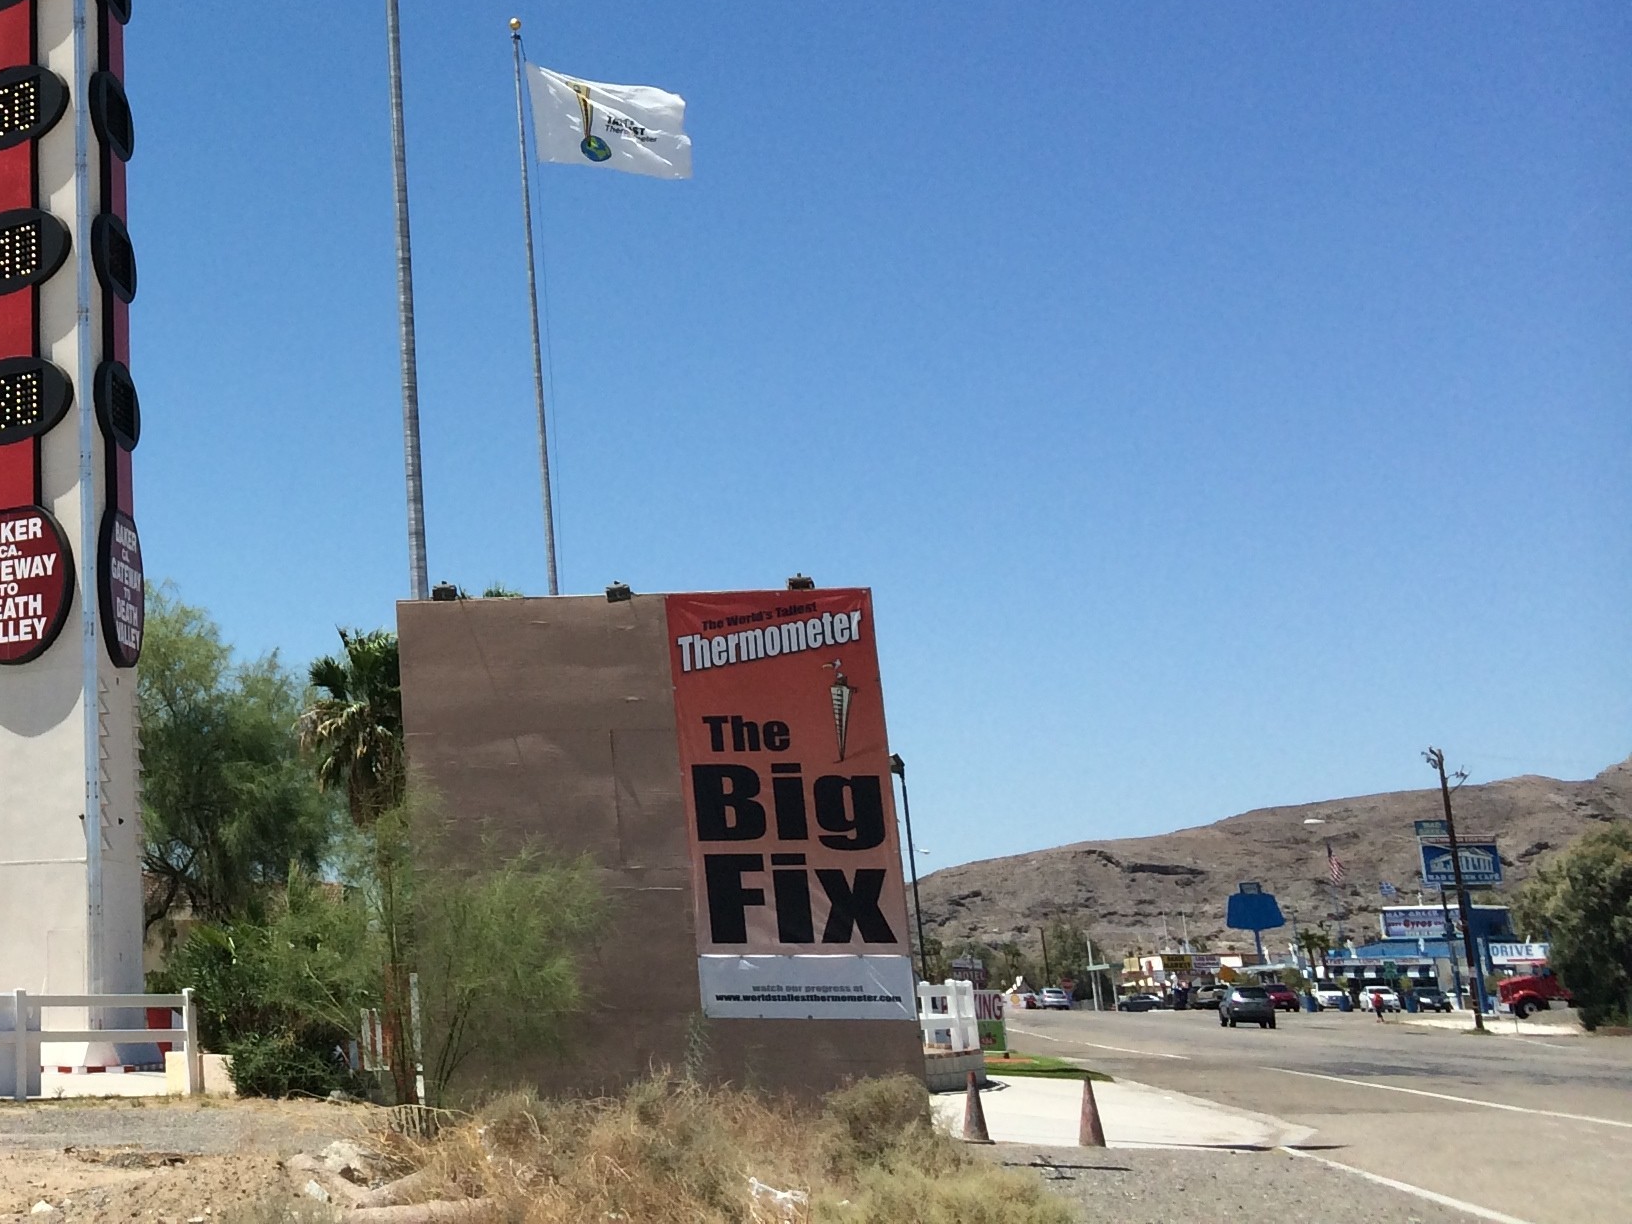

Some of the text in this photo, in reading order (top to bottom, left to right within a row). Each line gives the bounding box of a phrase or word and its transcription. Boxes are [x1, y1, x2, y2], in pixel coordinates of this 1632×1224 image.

[111, 557, 142, 593] GATEWAY
[116, 596, 139, 628] DEATH
[701, 601, 818, 631] The World's Tallest
[677, 609, 862, 673] Thermometer
[701, 715, 791, 753] The
[691, 763, 886, 851] Big
[704, 853, 898, 945] Fix
[1491, 945, 1534, 957] DRIVE
[752, 984, 864, 994] watch our progress at
